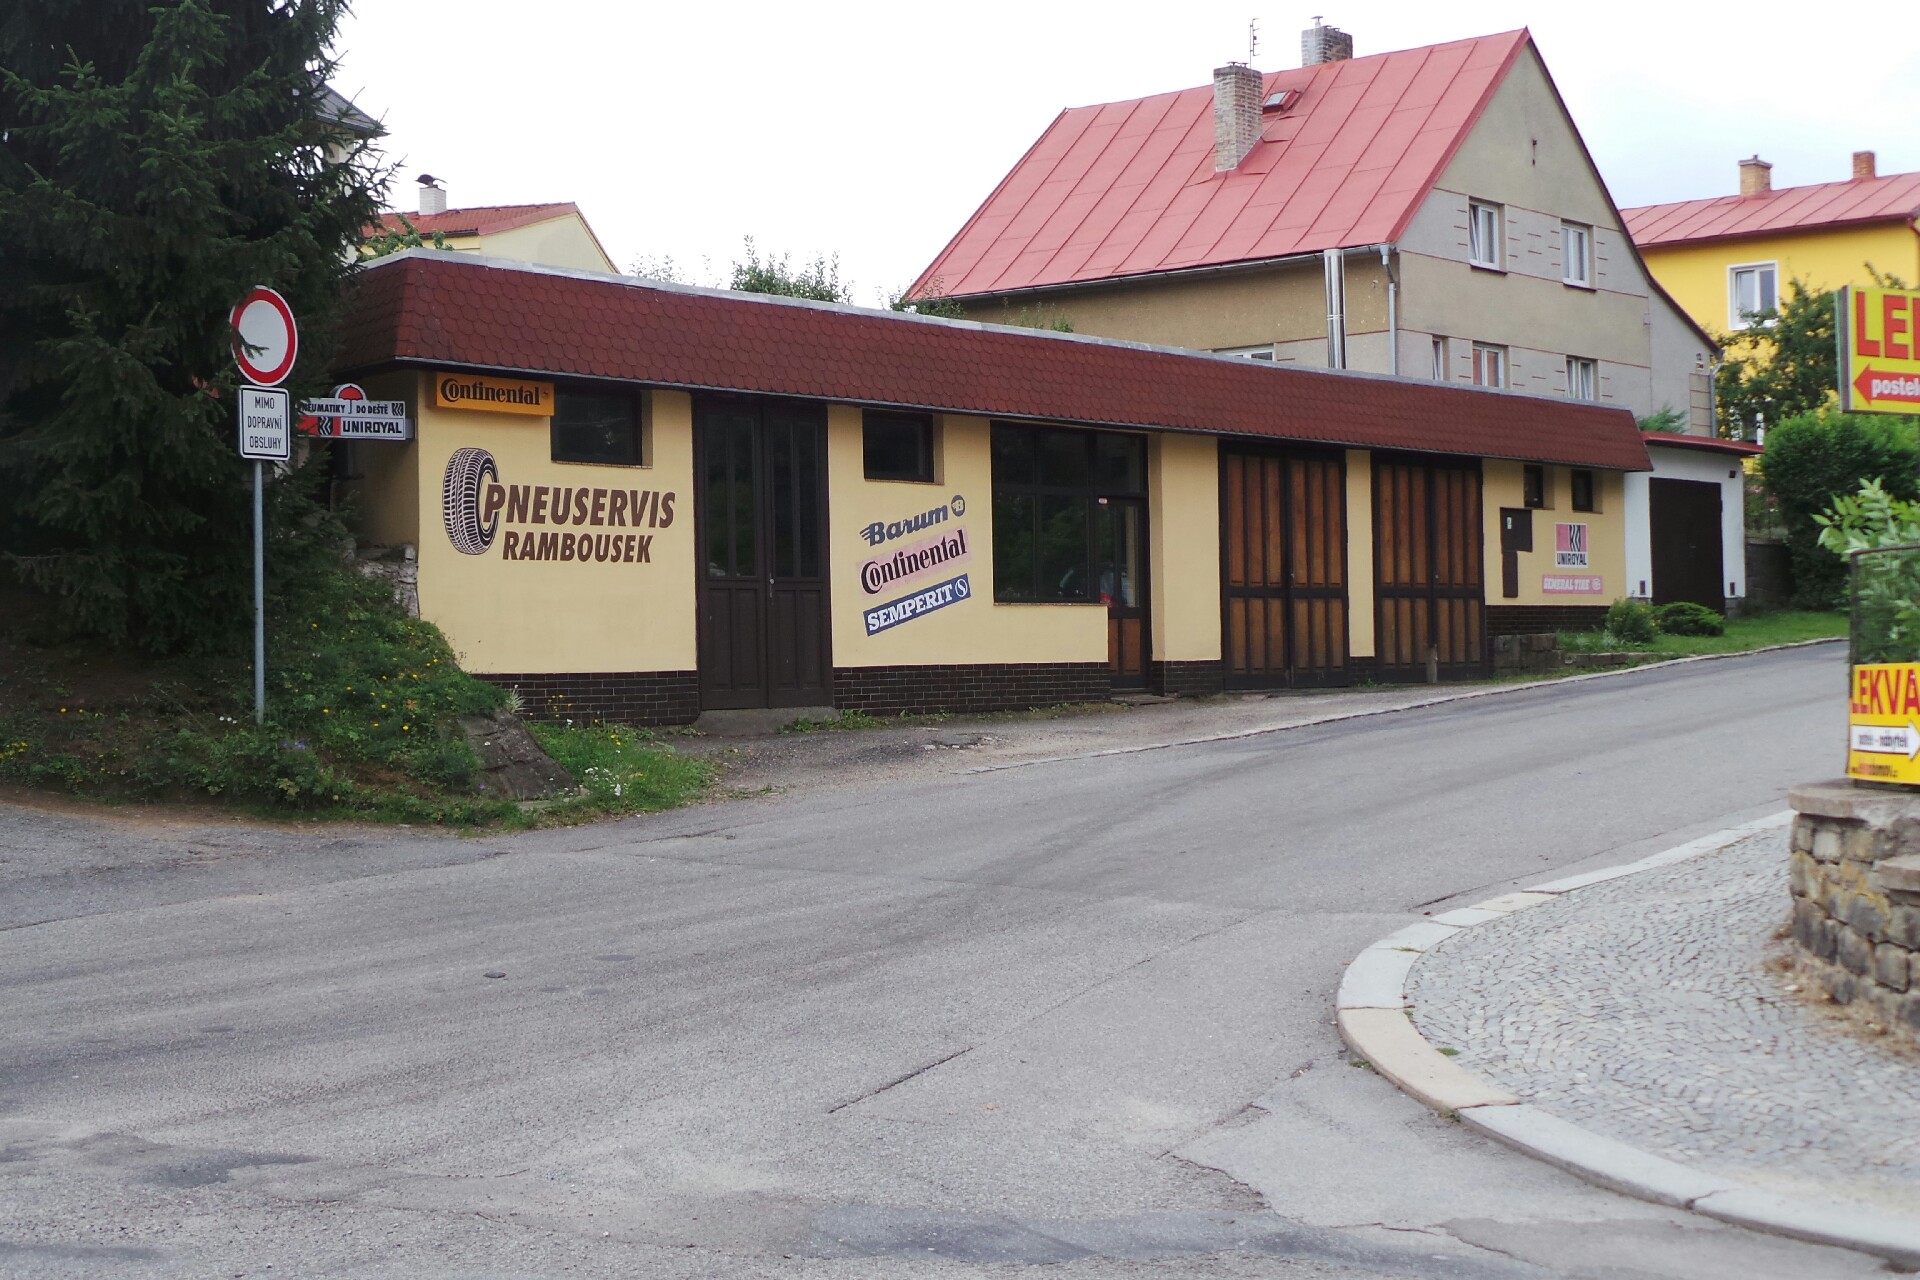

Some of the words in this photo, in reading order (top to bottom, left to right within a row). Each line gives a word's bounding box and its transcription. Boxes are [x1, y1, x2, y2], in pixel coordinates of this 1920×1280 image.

[1856, 290, 1920, 360] LE
[254, 396, 275, 410] MIMO
[440, 378, 540, 405] Continental
[301, 403, 345, 414] NEUMATIKY
[356, 405, 366, 414] DO
[367, 404, 389, 414] DEŠTĚ
[247, 415, 282, 430] DOPRAVNÍ
[343, 420, 402, 434] UNIROYAL
[249, 436, 282, 450] OBSLUHY
[483, 484, 675, 529] PNEUSERVIS
[860, 505, 949, 546] Barum
[503, 531, 654, 563] RAMBOUSEK
[1557, 553, 1587, 565] UNIROYAL
[861, 529, 967, 594] Continental
[867, 584, 953, 631] SEMPERIT
